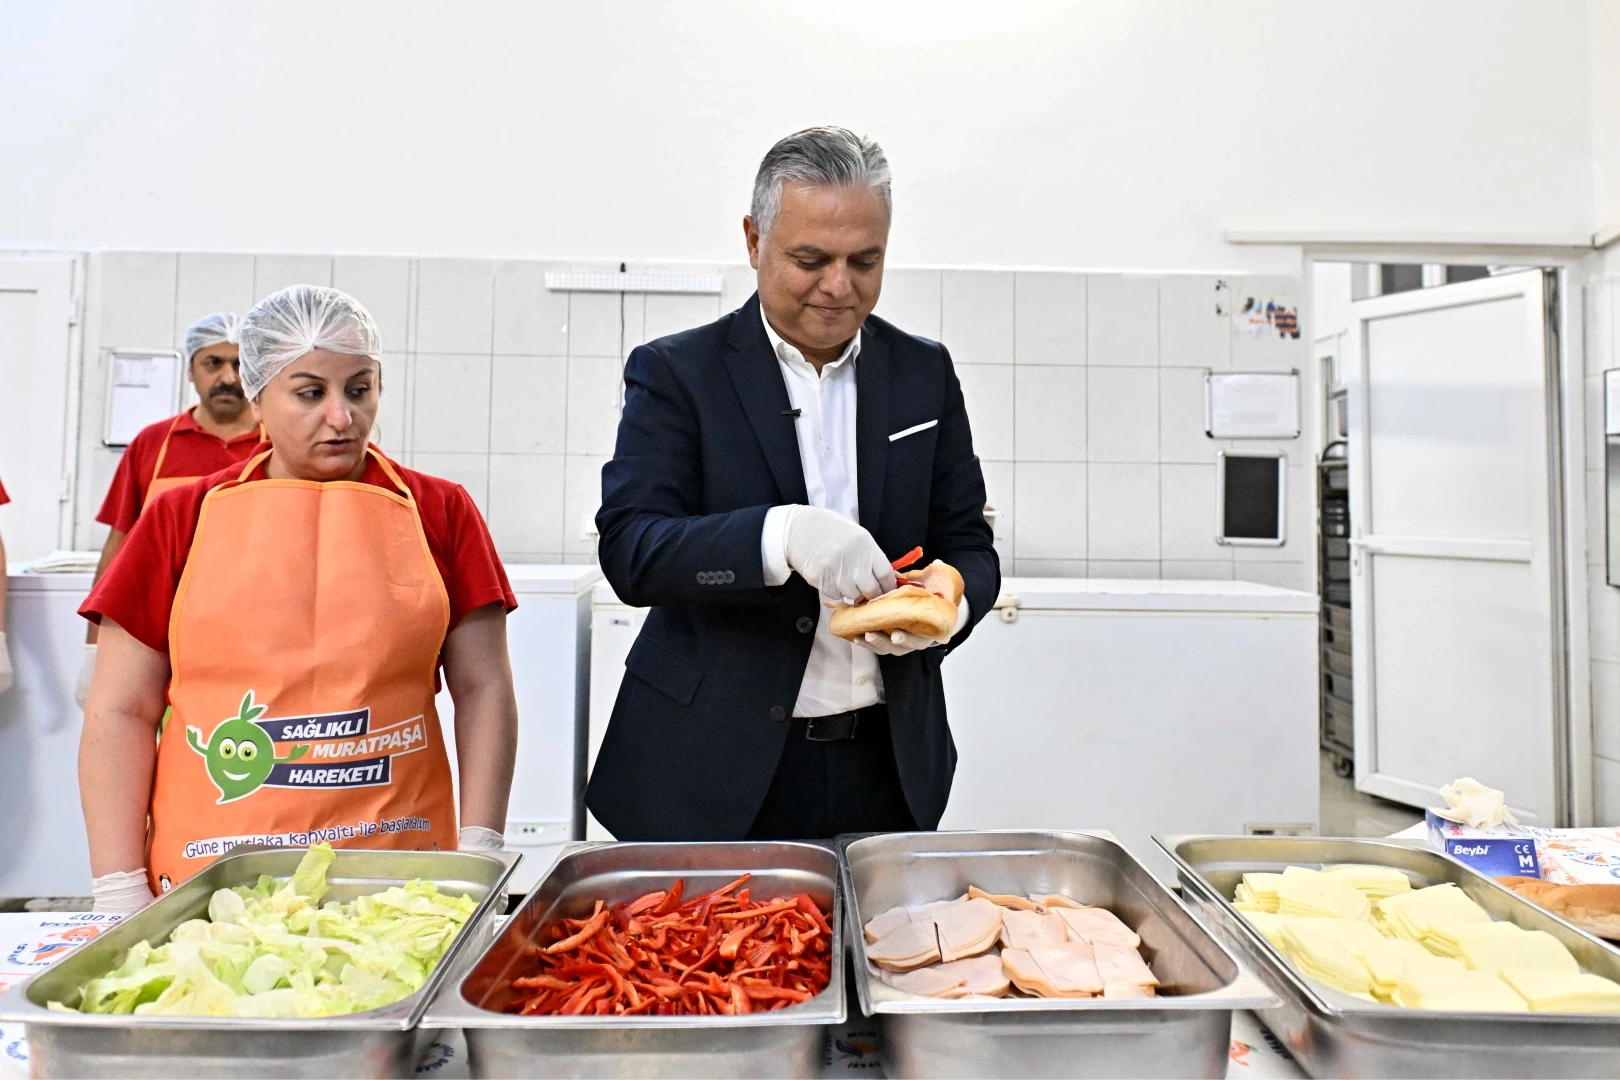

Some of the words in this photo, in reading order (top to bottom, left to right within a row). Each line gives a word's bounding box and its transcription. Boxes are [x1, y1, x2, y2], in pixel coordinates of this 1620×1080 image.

[281, 718, 364, 740] SAĞLIKLI
[311, 724, 423, 759] MURATPAŞA
[288, 759, 384, 784] HAREKETİ
[185, 839, 219, 859] Güne
[289, 826, 355, 844] kahvaltı
[359, 822, 377, 836] ile
[1453, 845, 1489, 857] Beybi
[1519, 855, 1534, 868] M
